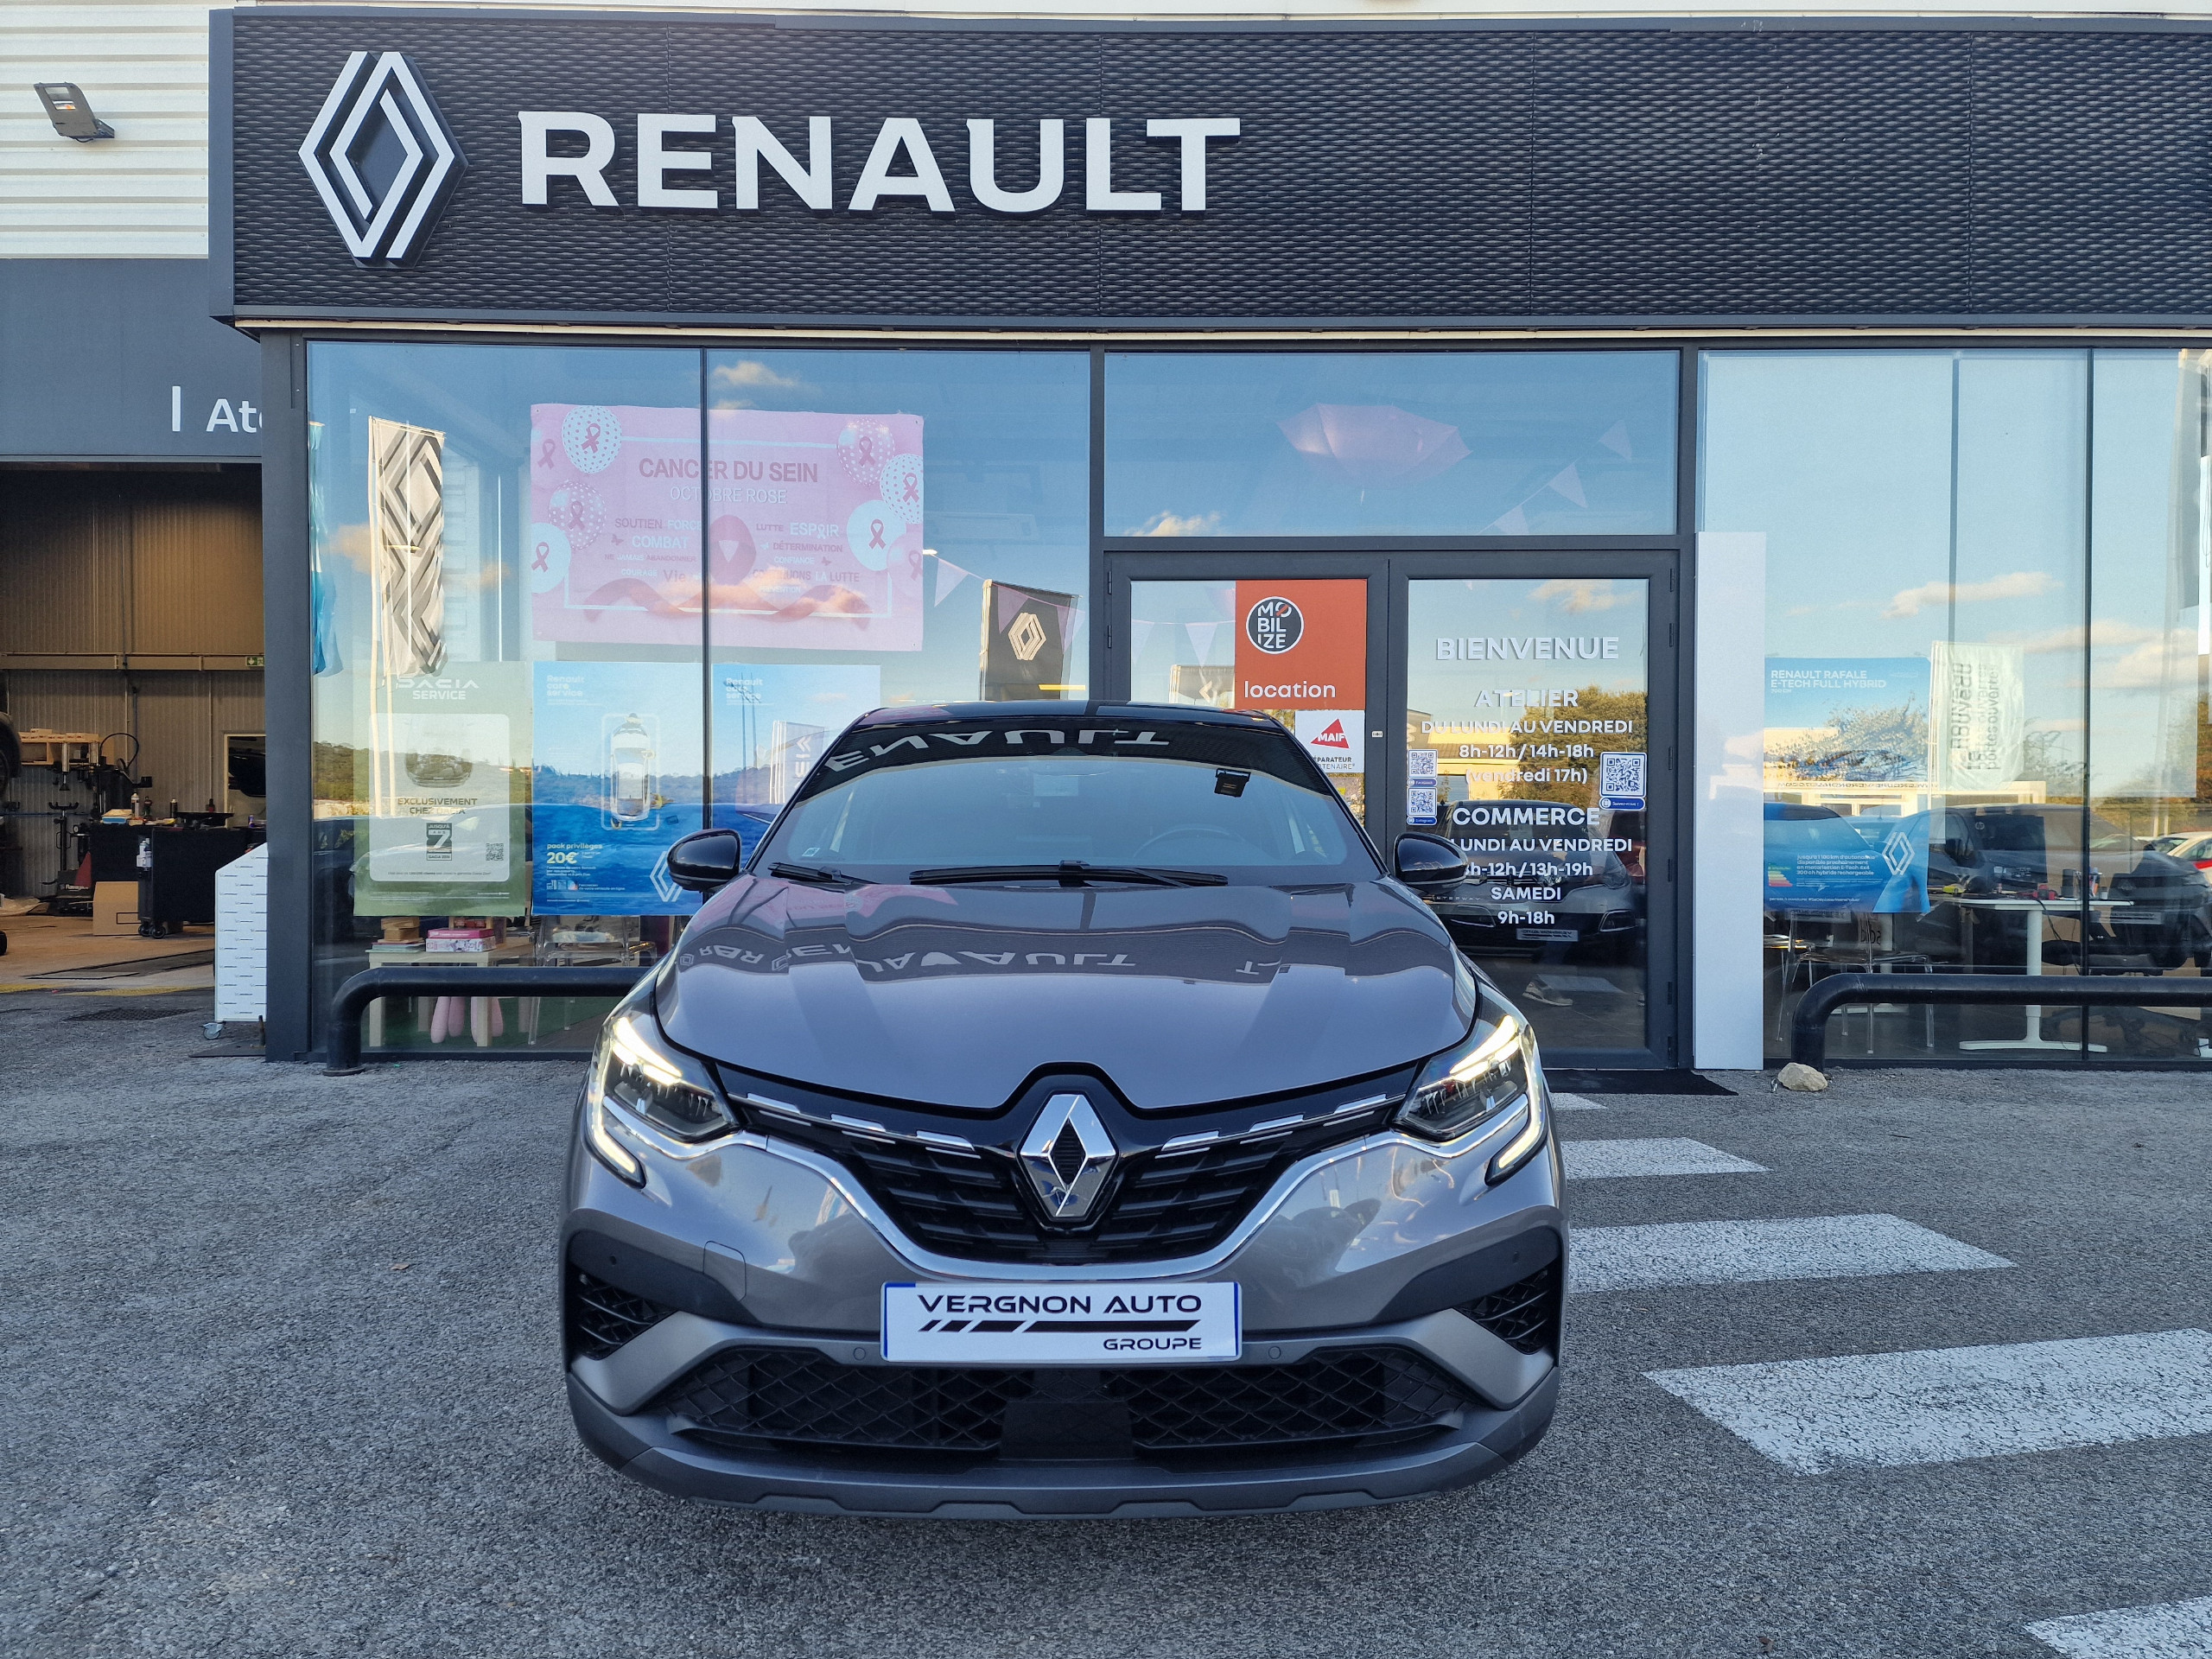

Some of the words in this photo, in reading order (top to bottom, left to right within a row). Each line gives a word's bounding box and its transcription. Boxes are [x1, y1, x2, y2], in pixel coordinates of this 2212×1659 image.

[518, 111, 1241, 213] RENAULT
[207, 398, 263, 433] At
[734, 461, 764, 480] DU
[769, 461, 817, 482] SEIN
[747, 489, 787, 504] ROSE
[615, 518, 663, 529] SOUTIEN
[632, 535, 690, 549] COMBAT
[772, 540, 843, 552] DÉTERMINATION
[663, 570, 686, 582] Vie
[815, 571, 827, 582] LA
[830, 572, 860, 582] LUTTE
[1258, 618, 1287, 632] BIL
[1436, 637, 1618, 660] BIENVENUE
[1770, 670, 1821, 679] RENAULT
[1824, 671, 1867, 679] RAFALE
[397, 679, 480, 689] DACIA
[1244, 681, 1336, 698] location
[1770, 679, 1810, 689] E-TECH
[1813, 680, 1841, 689] FULL
[1843, 680, 1886, 689] HYBRID
[412, 690, 467, 700] SERVICE
[1475, 690, 1579, 708] ATELIER
[1421, 721, 1447, 734] DU
[1452, 721, 1505, 734] LUNDI
[1510, 721, 1536, 734] AU
[1540, 720, 1633, 734] VENDREDI
[1318, 732, 1346, 742] MAIF
[1459, 744, 1516, 759] 8h-12h
[1530, 744, 1594, 758] 14h-18h
[1465, 768, 1550, 785] (vendredi
[1554, 767, 1588, 784] 17h)
[1452, 807, 1600, 825] COMMERCE
[1510, 838, 1535, 852] AU
[1541, 838, 1632, 851] VENDREDI
[1531, 862, 1593, 876] 13h-19h
[1491, 887, 1561, 900] SAMEDI
[1497, 911, 1555, 925] 9h-18h
[917, 1294, 1091, 1313] VERGNON
[1103, 1294, 1202, 1313] AUTO
[1103, 1338, 1202, 1351] GROUPE
